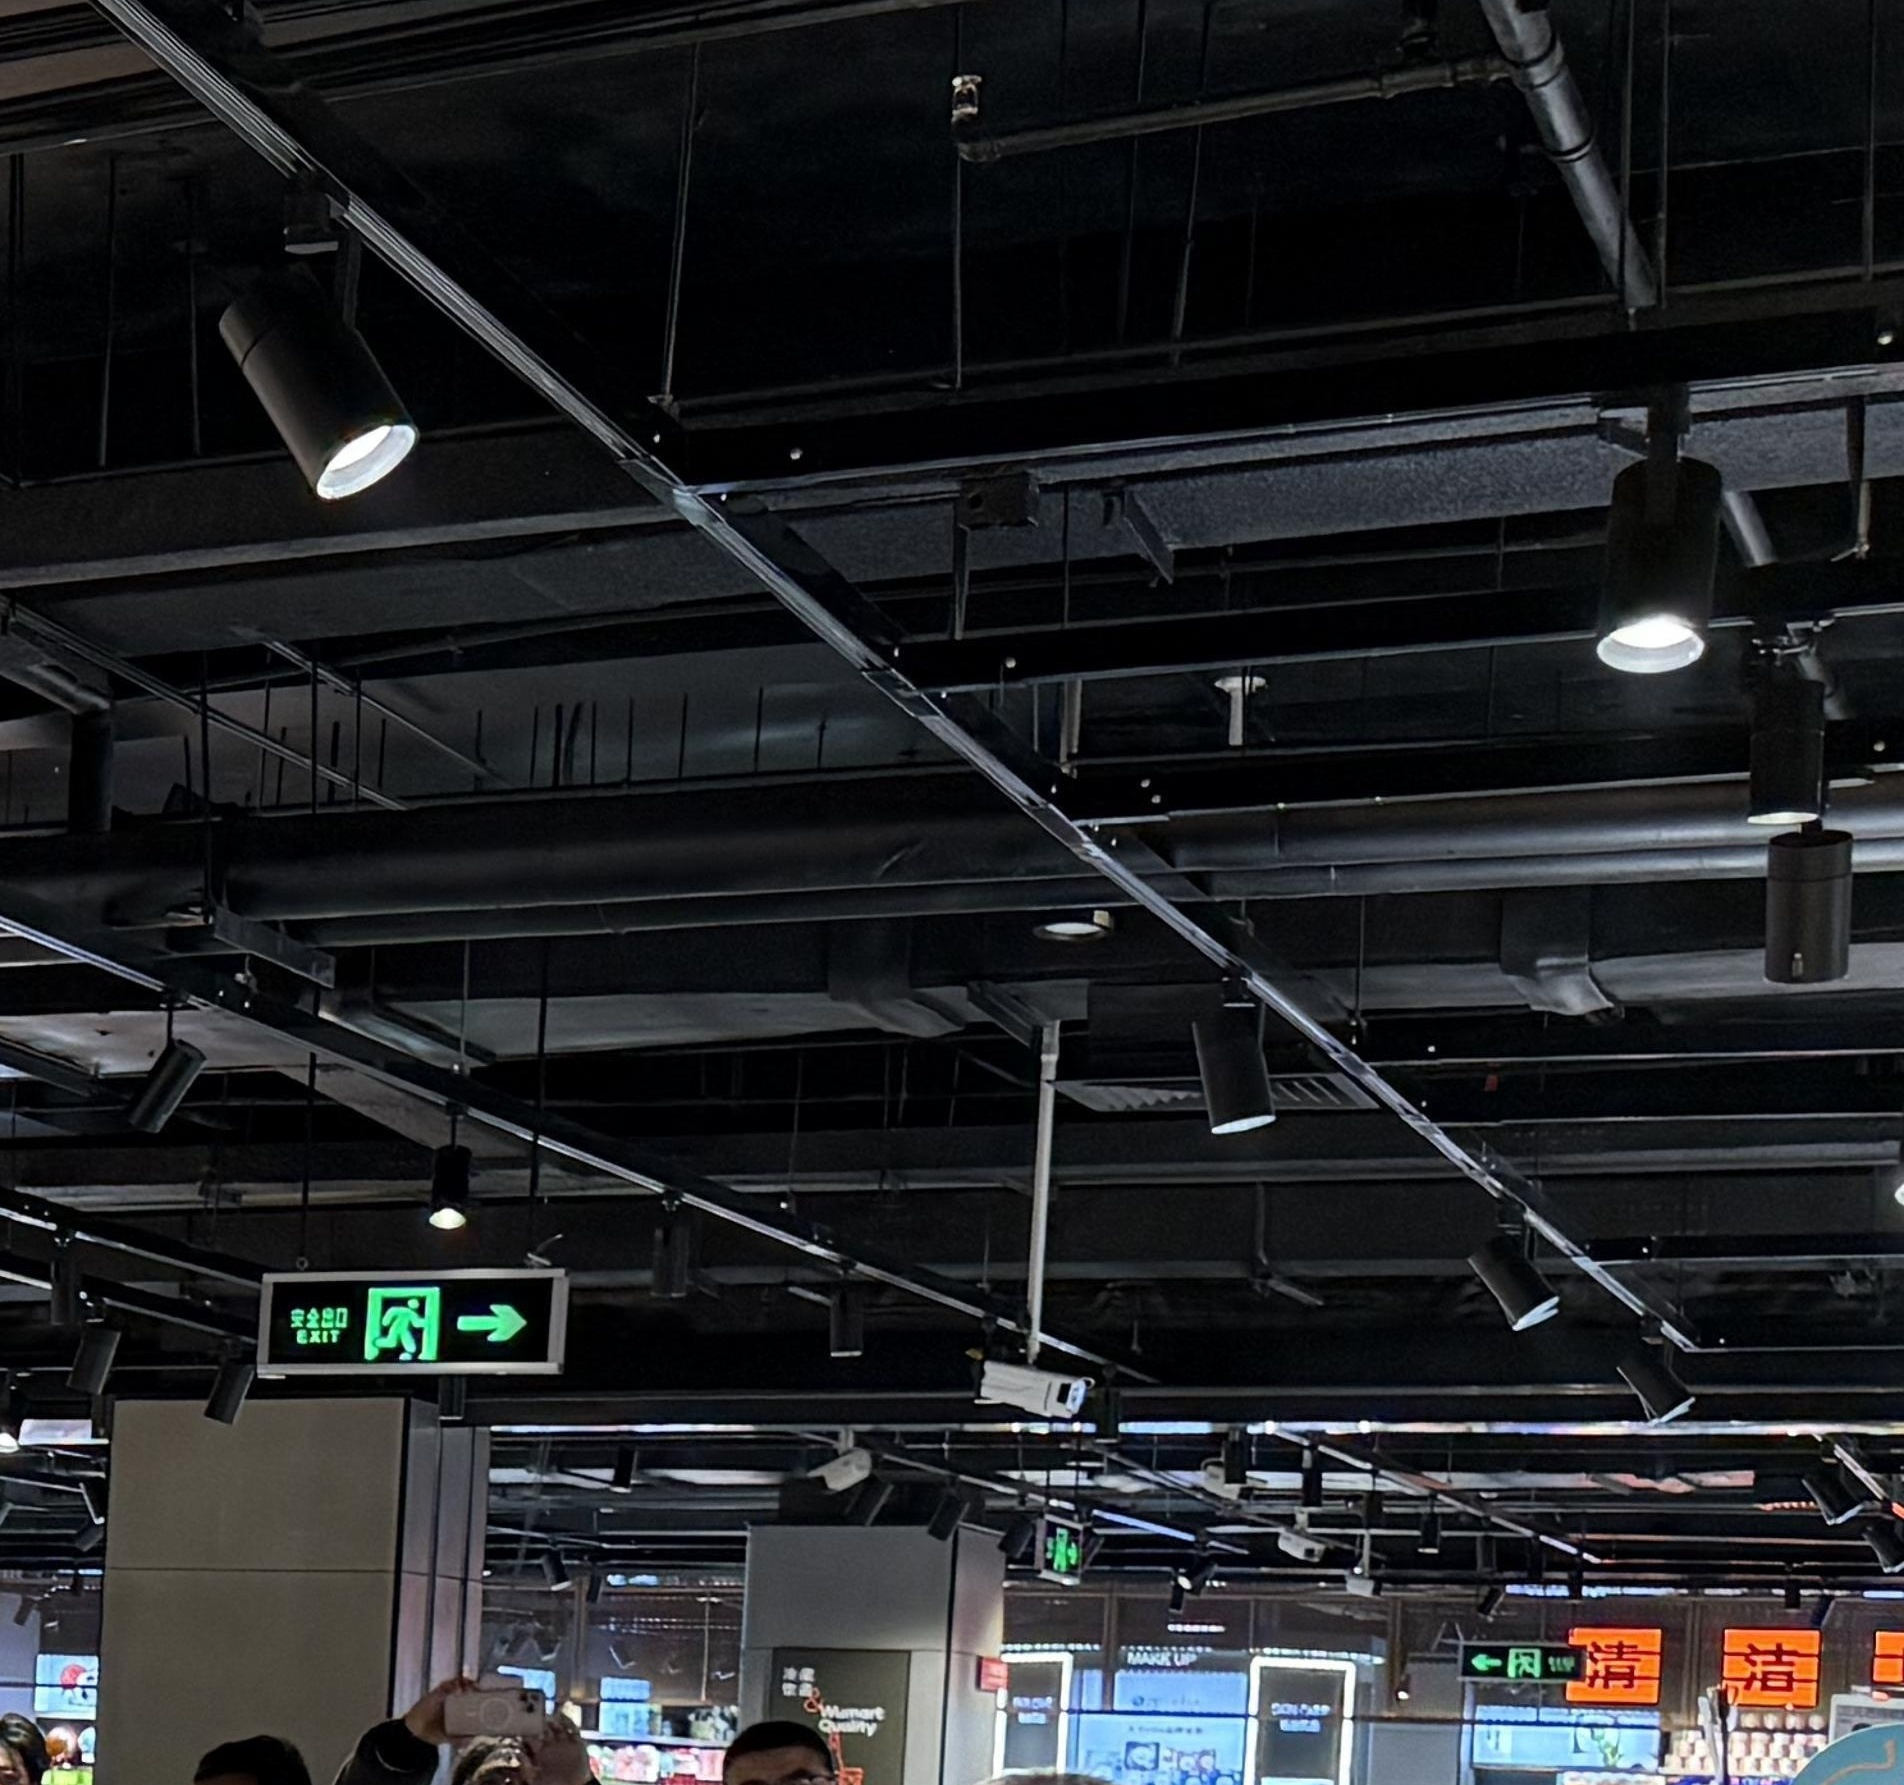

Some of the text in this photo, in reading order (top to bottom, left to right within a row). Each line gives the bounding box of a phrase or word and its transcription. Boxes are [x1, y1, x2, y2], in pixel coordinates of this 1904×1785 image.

[296, 1329, 340, 1345] EXIT
[1587, 1640, 1796, 1692] 清 洁
